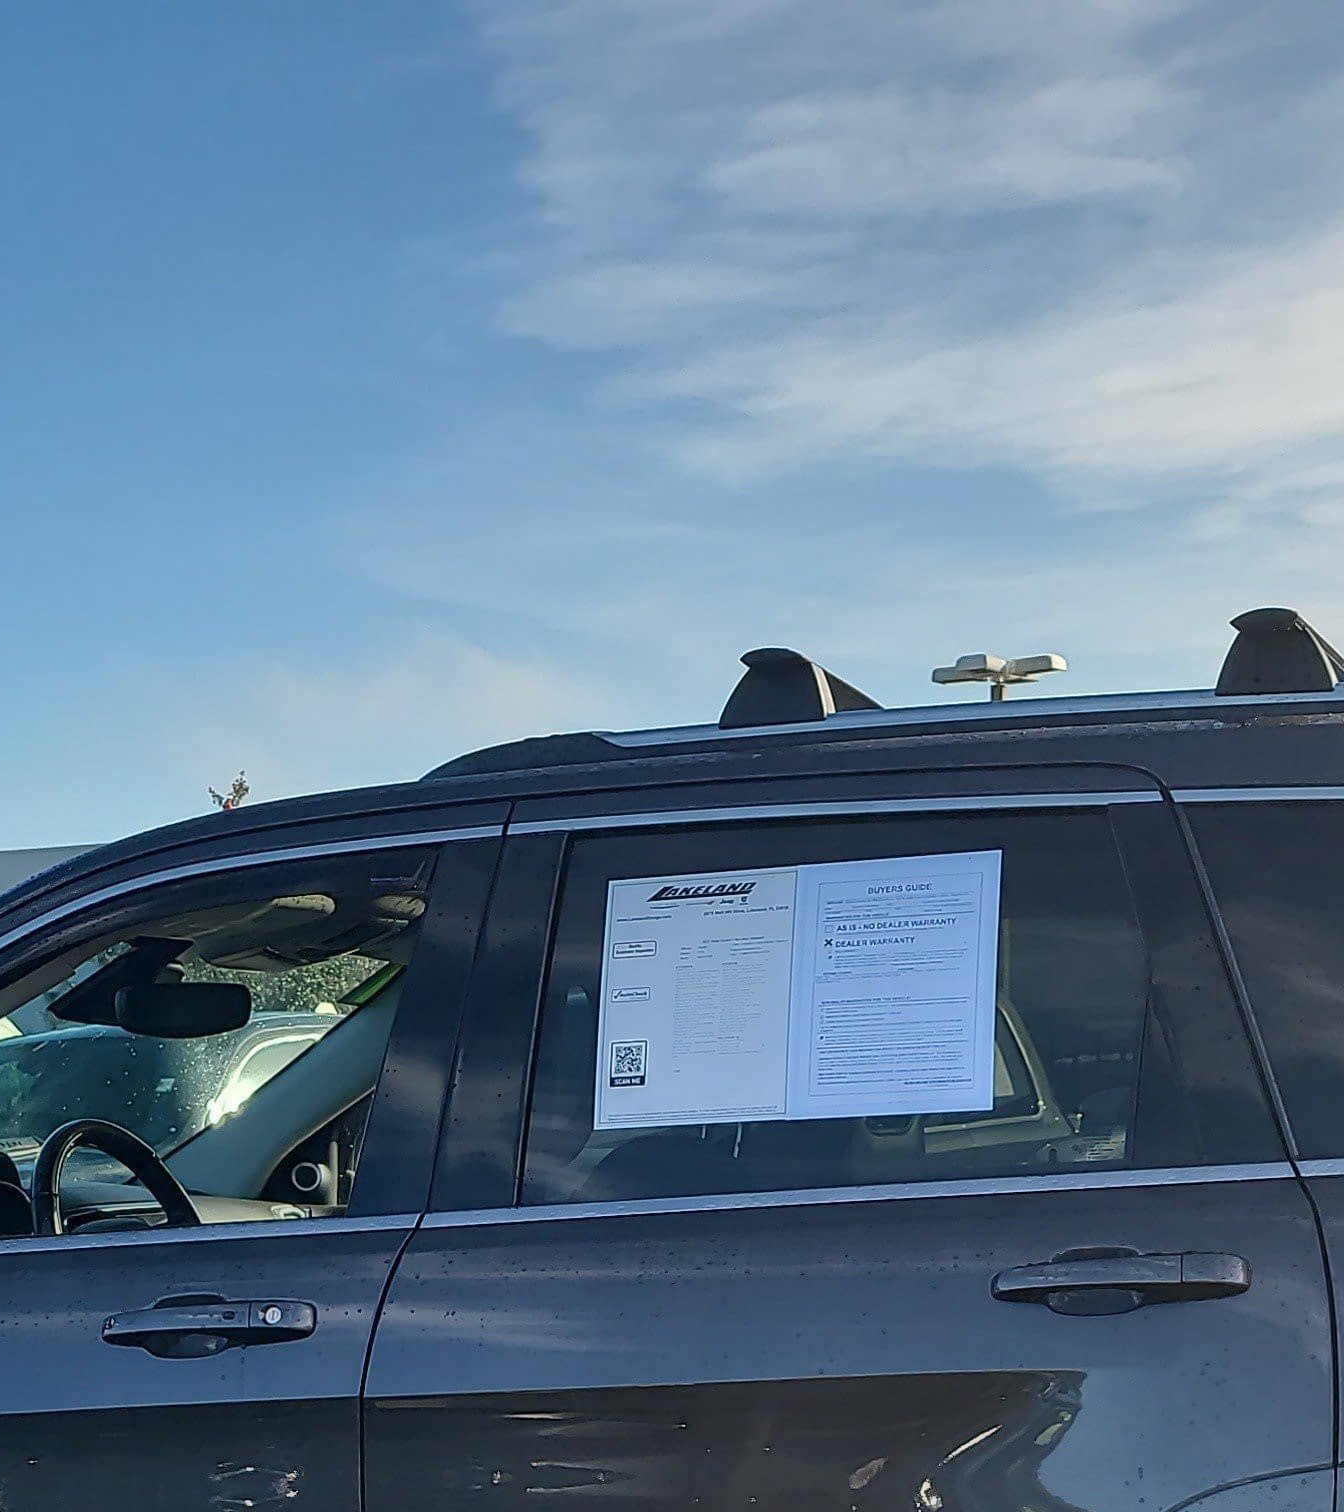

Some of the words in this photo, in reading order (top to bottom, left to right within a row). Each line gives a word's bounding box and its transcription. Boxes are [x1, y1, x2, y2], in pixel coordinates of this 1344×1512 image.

[646, 882, 757, 902] LAKELAND
[867, 885, 903, 895] BUYERS
[905, 883, 932, 892] GUIDE
[836, 924, 847, 932] AS
[863, 922, 876, 930] NO
[876, 920, 910, 930] DEALER
[911, 918, 957, 927] WARRANTY
[835, 939, 868, 948] DEALER
[869, 936, 916, 946] WARRANTY
